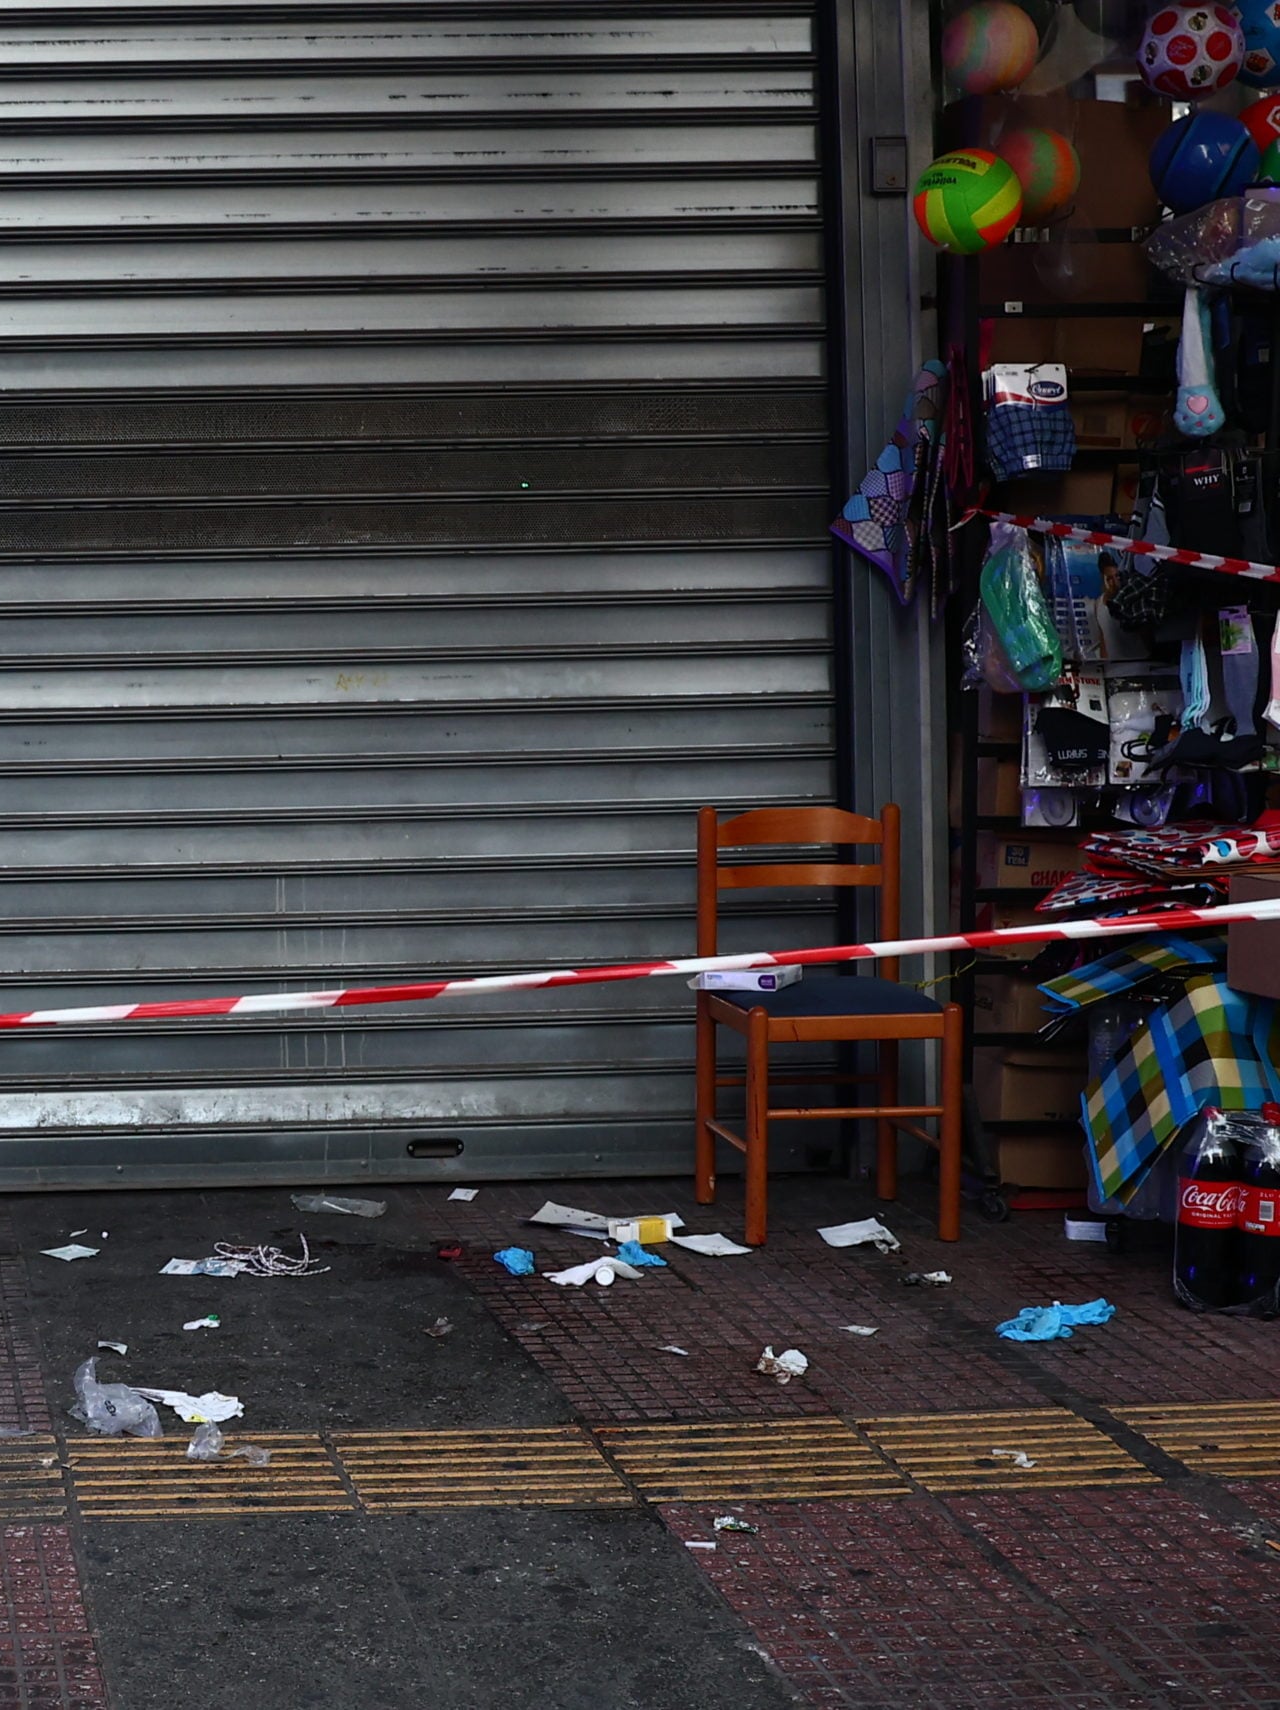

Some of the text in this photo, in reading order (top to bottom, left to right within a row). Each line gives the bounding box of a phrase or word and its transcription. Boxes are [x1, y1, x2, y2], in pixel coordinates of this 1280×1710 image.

[1193, 474, 1220, 486] WHY
[1182, 1184, 1249, 1213] Coca-Cola
[1191, 1211, 1222, 1219] ORIGINAL
